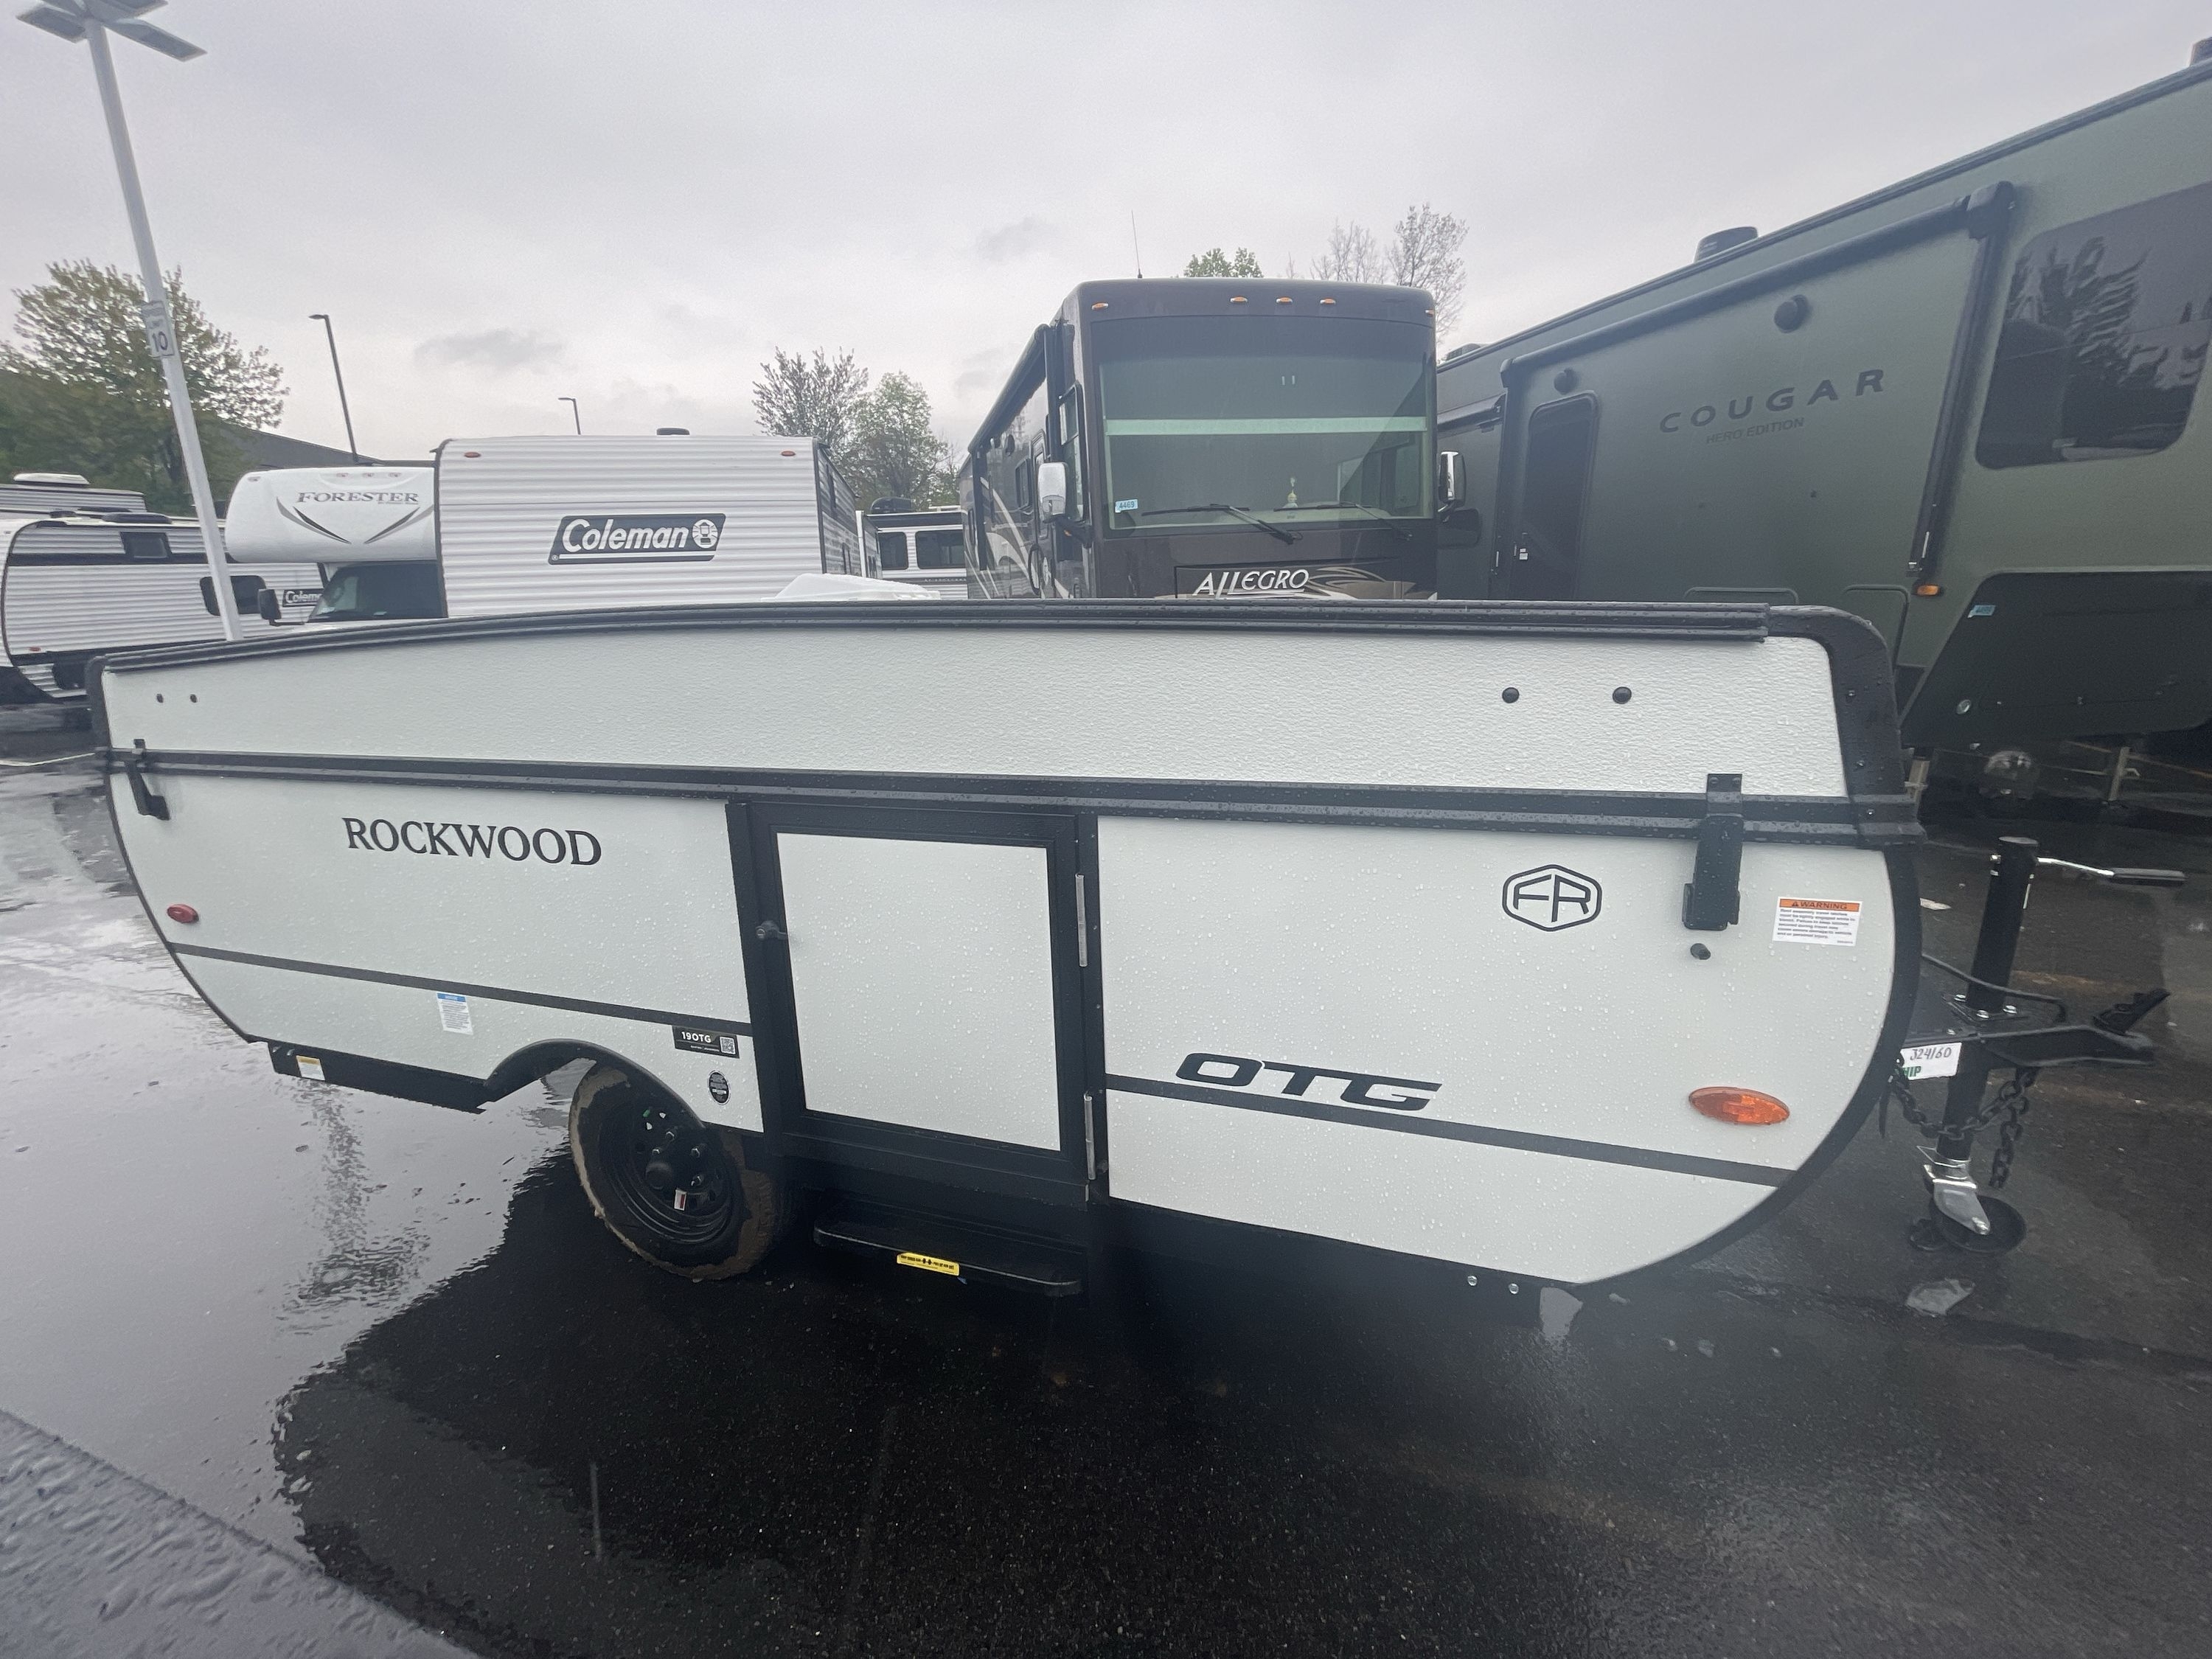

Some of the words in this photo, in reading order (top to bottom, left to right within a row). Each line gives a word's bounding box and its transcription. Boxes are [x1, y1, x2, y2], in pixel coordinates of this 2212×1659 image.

[152, 331, 169, 352] 10
[1659, 369, 1884, 434] COUGAR
[1706, 429, 1742, 443] HERO
[1746, 417, 1805, 437] EDITION
[296, 492, 420, 503] FORESTER
[562, 518, 690, 553] Coleman
[285, 591, 322, 603] Colem
[1192, 568, 1310, 599] ALLEGRO
[341, 817, 602, 866] ROCKWOOD
[1800, 901, 1848, 910] WARNING
[1175, 1052, 1443, 1112] OTG
